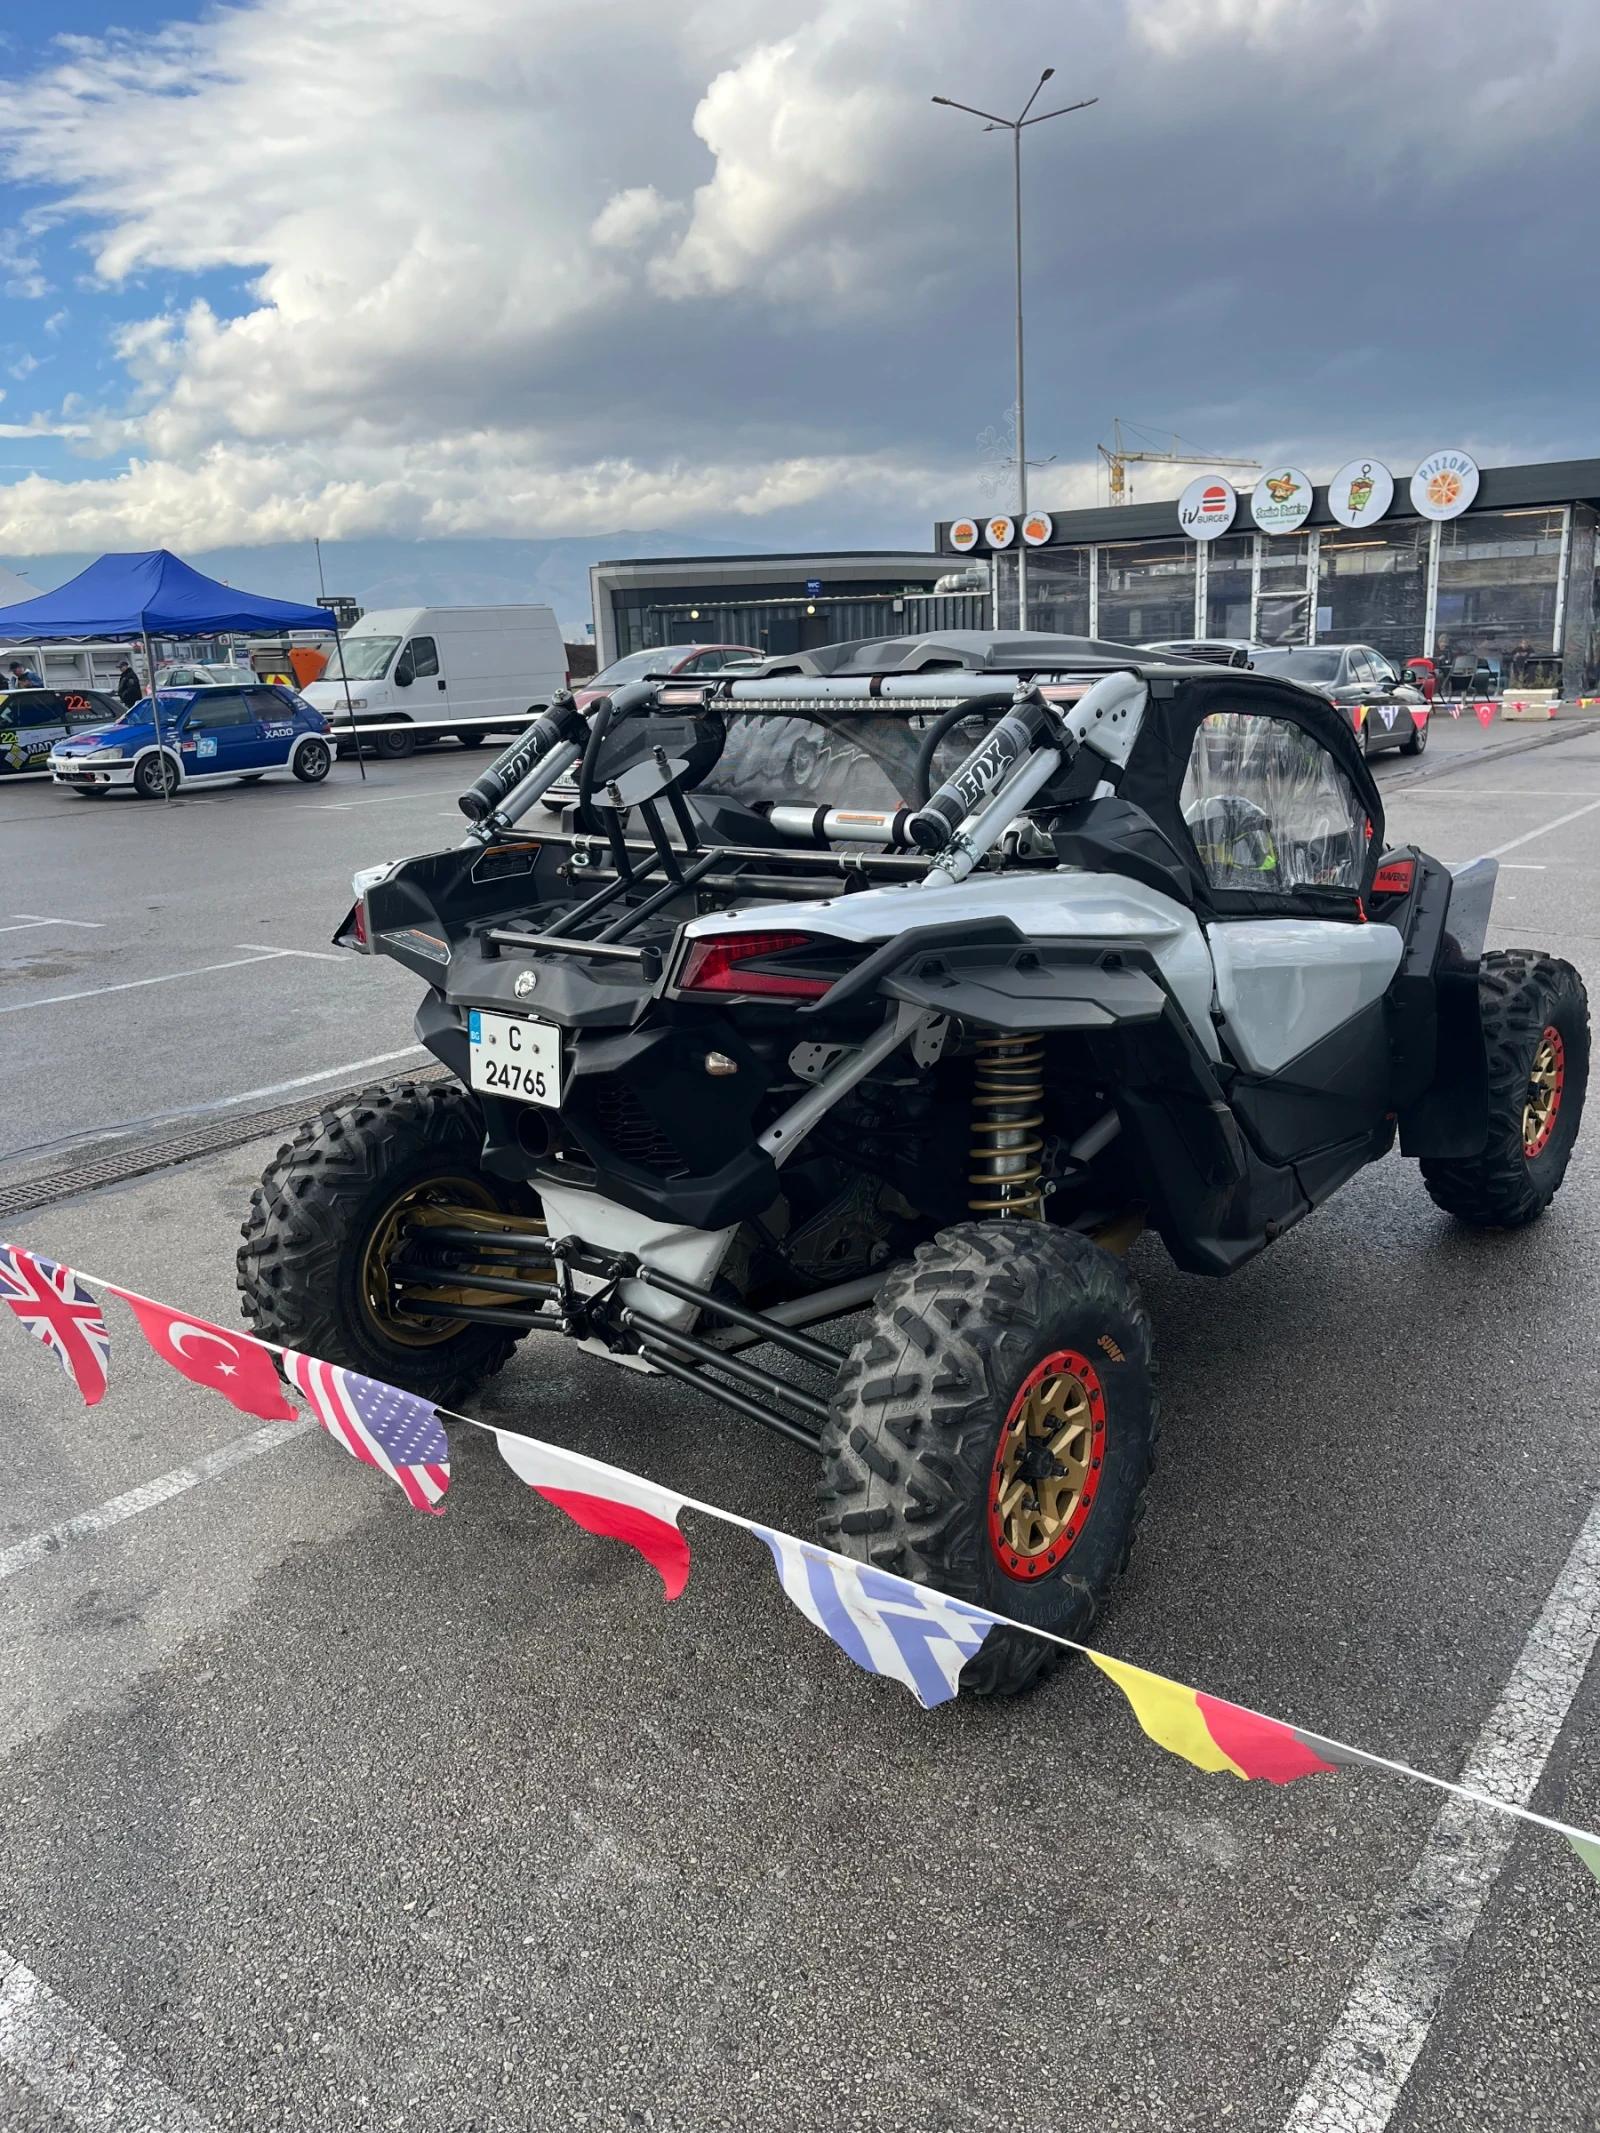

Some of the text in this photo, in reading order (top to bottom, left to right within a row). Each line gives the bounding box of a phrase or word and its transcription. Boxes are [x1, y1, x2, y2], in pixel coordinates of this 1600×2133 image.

[1419, 457, 1474, 481] PIZZONI
[1197, 514, 1230, 524] BURGER
[264, 728, 294, 740] XADO
[200, 741, 214, 755] 52
[498, 737, 541, 792] FOX
[955, 738, 1007, 807] FOX
[470, 1031, 480, 1040] BG
[509, 1026, 521, 1051] C
[486, 1060, 546, 1097] 24765
